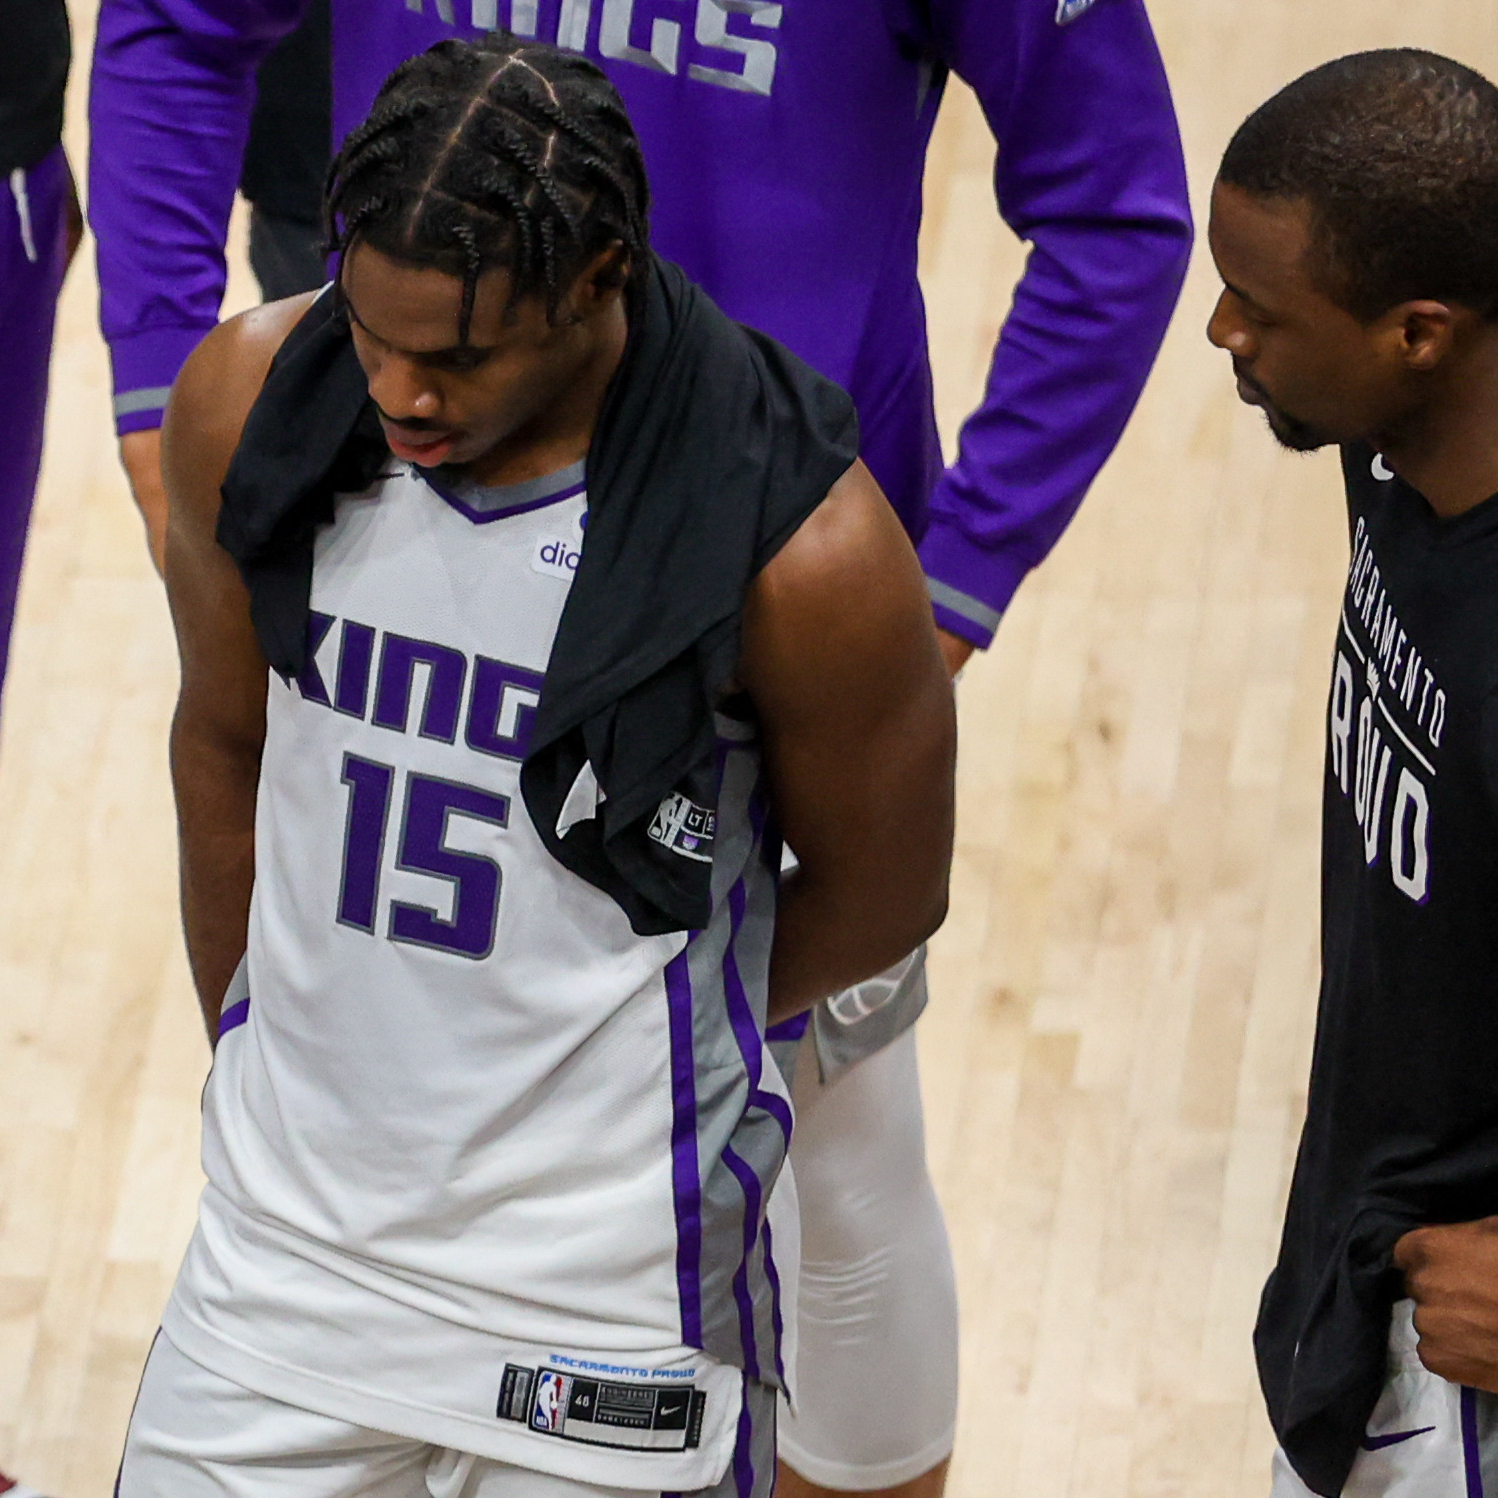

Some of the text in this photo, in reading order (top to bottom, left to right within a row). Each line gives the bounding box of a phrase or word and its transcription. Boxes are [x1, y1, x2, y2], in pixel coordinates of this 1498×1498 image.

[1349, 516, 1447, 748] SACRAMENTO
[336, 751, 511, 961] 15
[550, 1354, 695, 1379] SACRAMENTO PROUD
